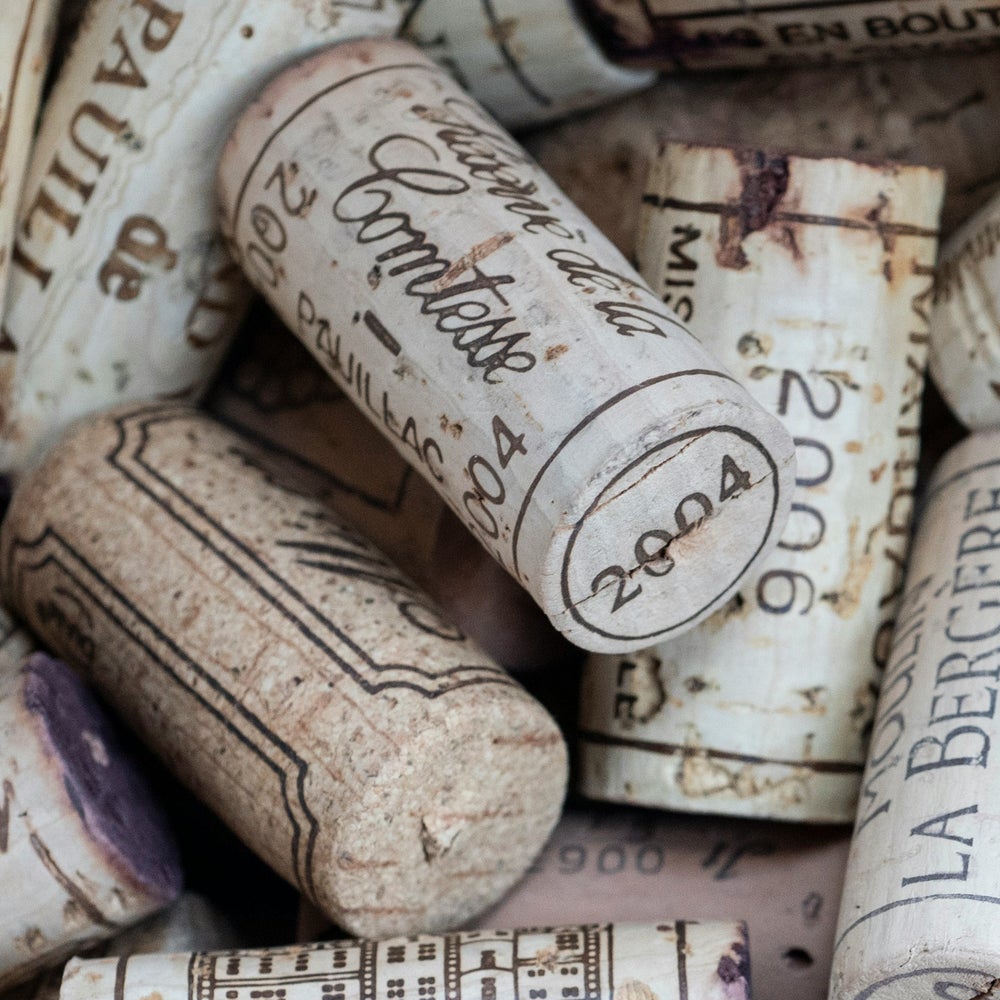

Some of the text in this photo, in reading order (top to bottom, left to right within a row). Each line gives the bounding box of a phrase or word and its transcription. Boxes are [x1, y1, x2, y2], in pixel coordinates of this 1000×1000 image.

[779, 22, 845, 46] EN
[0, 0, 184, 352] PAUILL
[98, 215, 178, 301] de
[333, 134, 536, 383] Comtesse
[547, 248, 656, 296] de
[595, 301, 702, 343] la
[462, 415, 532, 550] 004
[591, 454, 752, 614] 2004
[902, 804, 978, 888] LA
